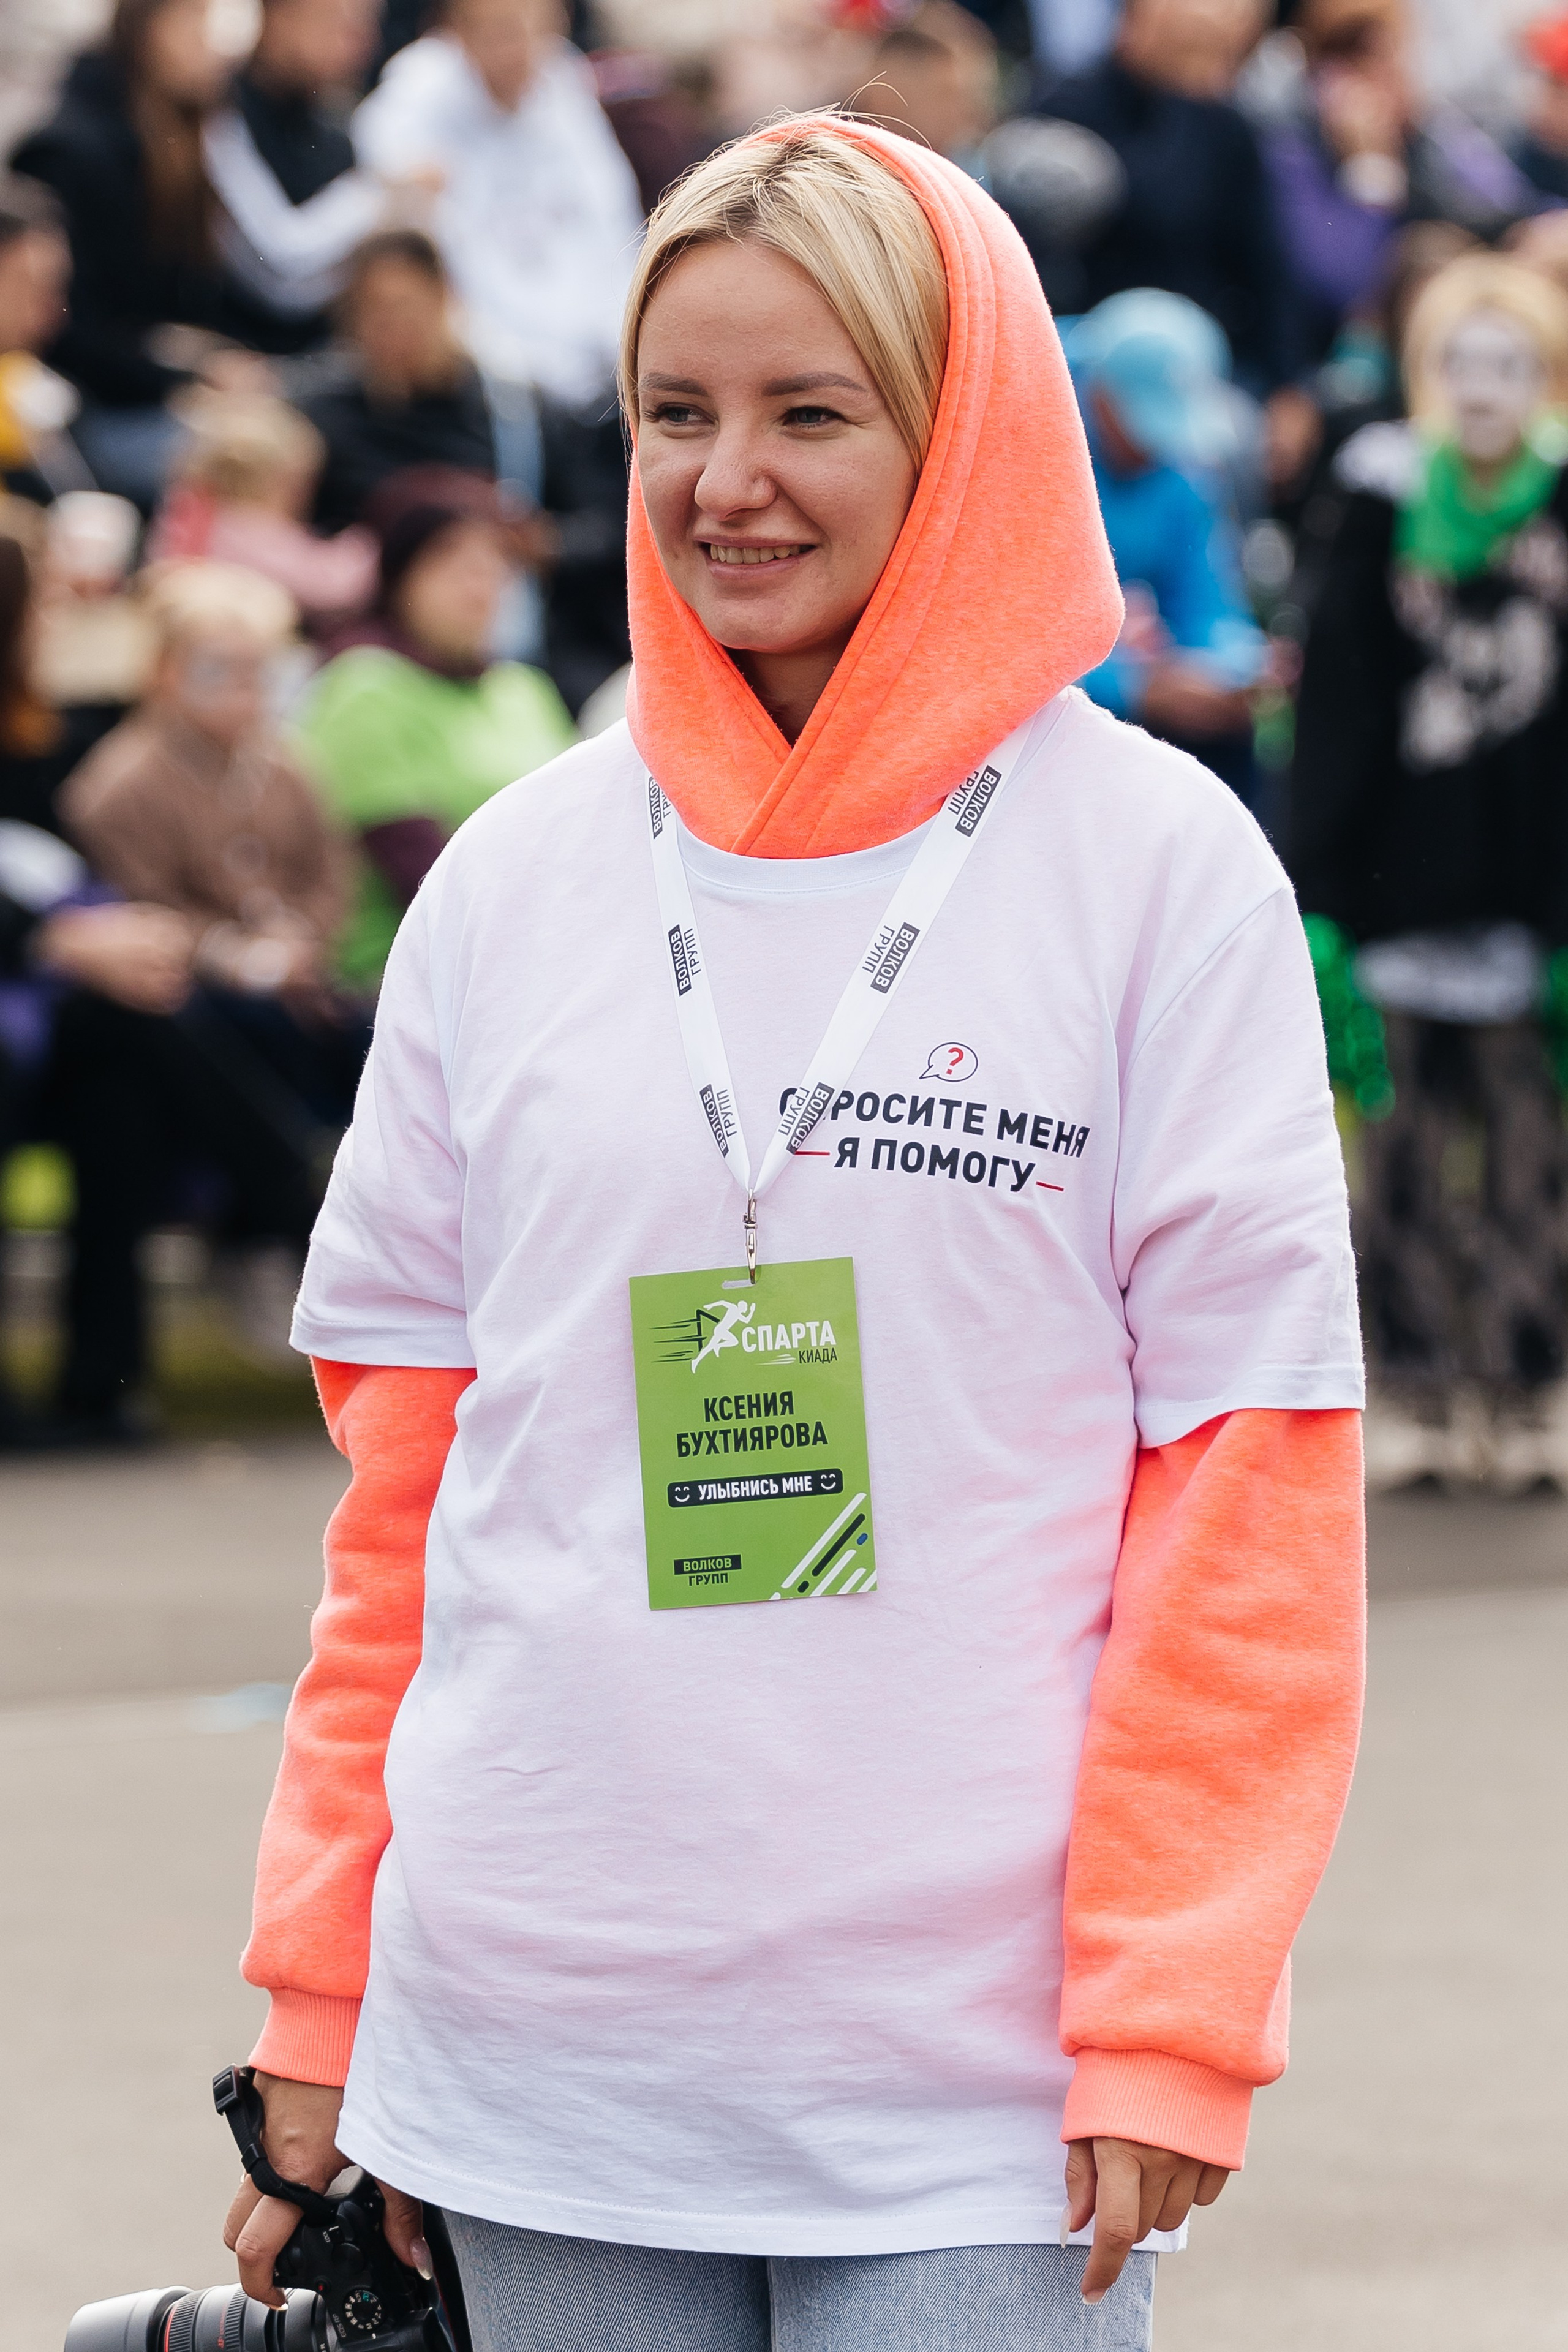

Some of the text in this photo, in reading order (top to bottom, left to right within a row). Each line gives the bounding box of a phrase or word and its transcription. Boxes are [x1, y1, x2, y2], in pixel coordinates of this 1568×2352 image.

[948, 771, 979, 815] ГРУПП
[960, 771, 997, 830] ВОЛКОВ
[671, 930, 690, 990] ВОЛКОВ
[684, 928, 701, 976] ГРУПП
[862, 925, 895, 974] ГРУПП
[875, 928, 915, 987] ВОЛКОВ
[703, 1090, 726, 1152] ВОЛКОВ
[717, 1089, 737, 1137] ГРУПП
[778, 1087, 810, 1136] ГРУПП
[779, 1087, 1091, 1158] СРОСИТЕ МЕНЯ
[791, 1088, 830, 1149] ВОЛКОВ
[834, 1137, 1036, 1192] Я ПОМОГУ
[741, 1320, 837, 1352] СПАРТА
[799, 1348, 837, 1364] КИАДА
[704, 1390, 794, 1422] КСЕНИЯ
[677, 1421, 828, 1457] БУХТИЯРОВА
[699, 1476, 812, 1501] УЛЫБНИСЬ МНЕ
[684, 1558, 732, 1572] ВОЛКОВ
[688, 1572, 728, 1586] ГРУПП
